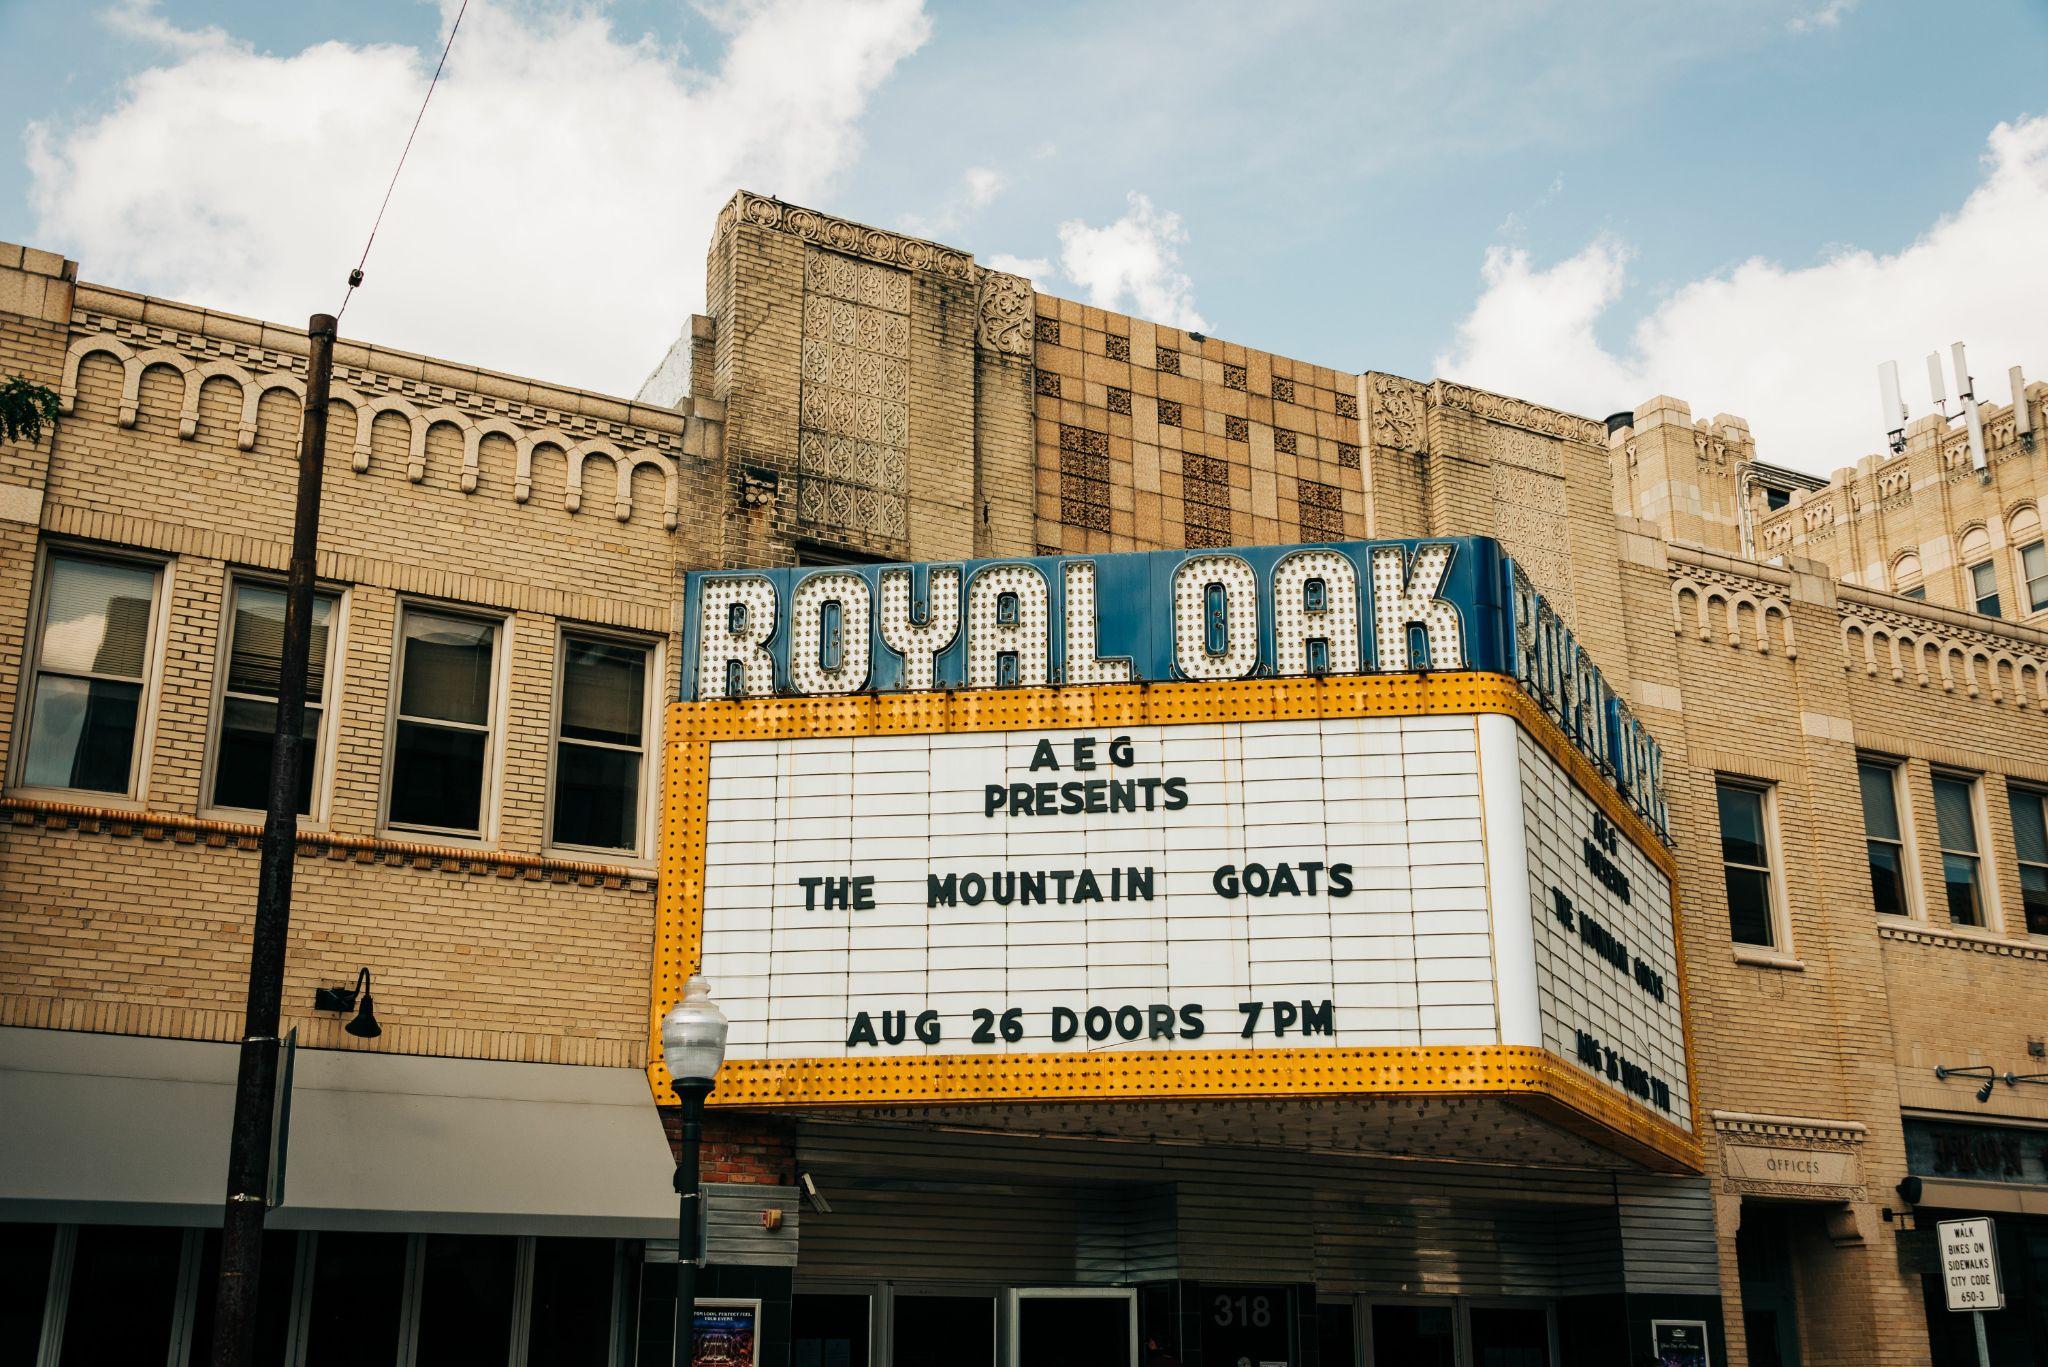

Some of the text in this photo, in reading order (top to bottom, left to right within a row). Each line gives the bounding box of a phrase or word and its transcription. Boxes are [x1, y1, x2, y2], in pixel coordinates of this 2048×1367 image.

[697, 543, 1466, 702] ROYAL OAK
[1029, 736, 1135, 772] AEG
[985, 777, 1190, 818] PRESENTS
[799, 862, 1354, 912] THE MOUNTAIN GOATS
[846, 1011, 942, 1047] AUG
[972, 1008, 1025, 1045] 26
[1052, 1004, 1206, 1043] DOORS
[1766, 1158, 1819, 1174] OFFICES
[1954, 1227, 1974, 1238] WALK
[1948, 1243, 1985, 1255] BIKES ON
[1948, 1258, 1989, 1271] SIDEWALKS
[1951, 1275, 1991, 1287] CITY CODE
[1961, 1291, 1985, 1302] 650-3
[1214, 1294, 1271, 1327] 318
